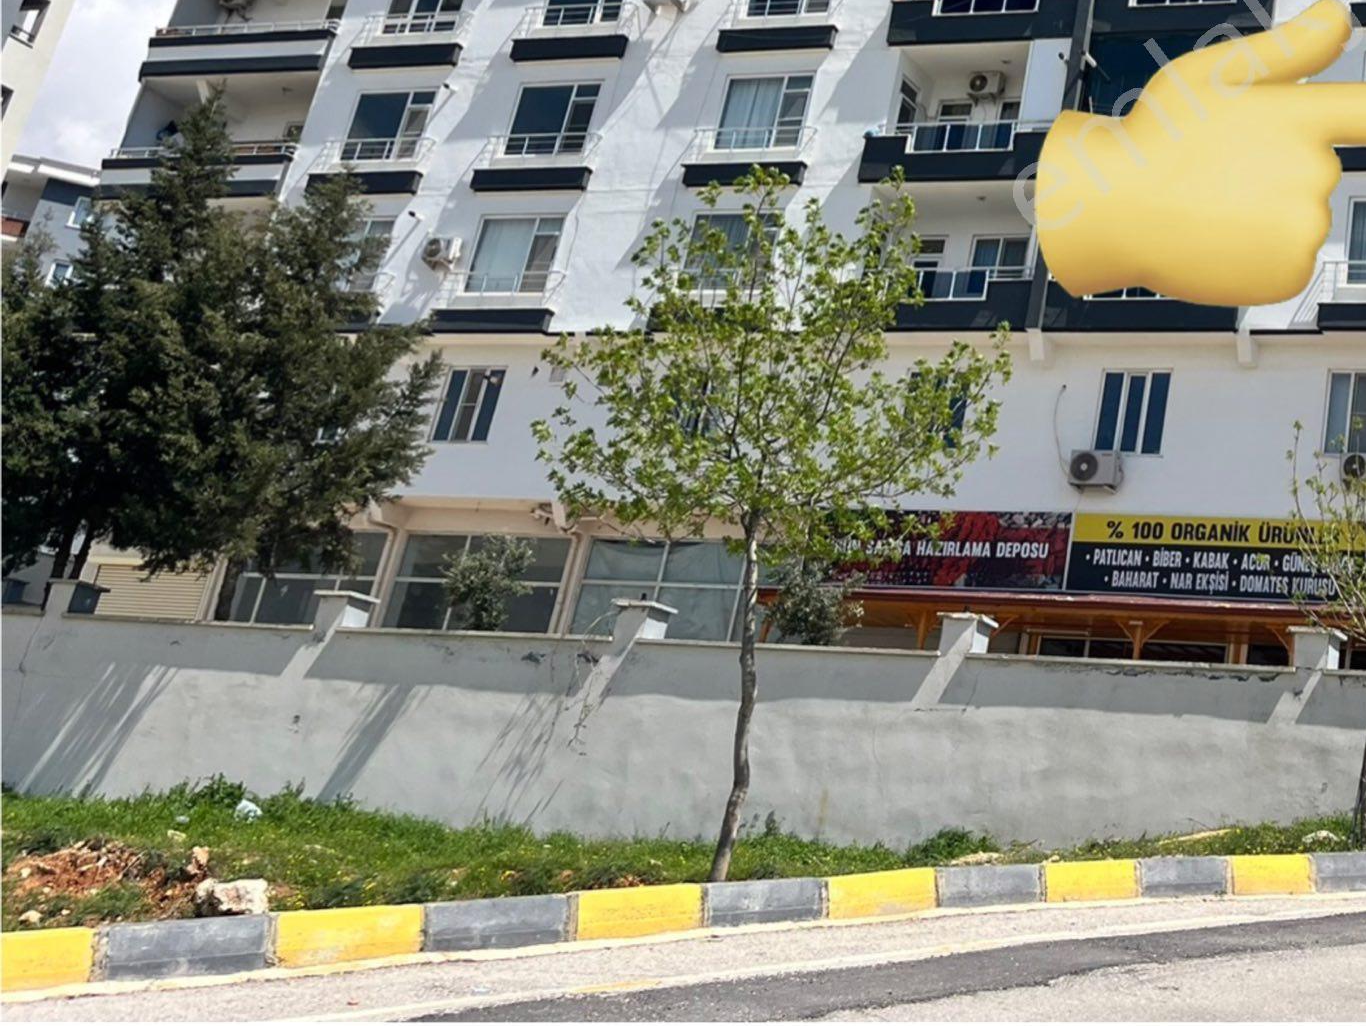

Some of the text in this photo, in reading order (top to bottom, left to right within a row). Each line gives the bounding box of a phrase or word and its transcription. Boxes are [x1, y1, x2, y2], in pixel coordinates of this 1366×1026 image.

[1132, 522, 1164, 540] 100
[1171, 521, 1251, 542] ORGANİK
[916, 540, 991, 558] HAZIRLAMA
[996, 541, 1049, 559] DEPOSU
[1093, 548, 1143, 567] PATLICAN
[1152, 547, 1182, 568] BİBER
[1193, 551, 1230, 570] KABAK
[1111, 570, 1160, 589] BAHARAT
[1170, 572, 1193, 589] NAR
